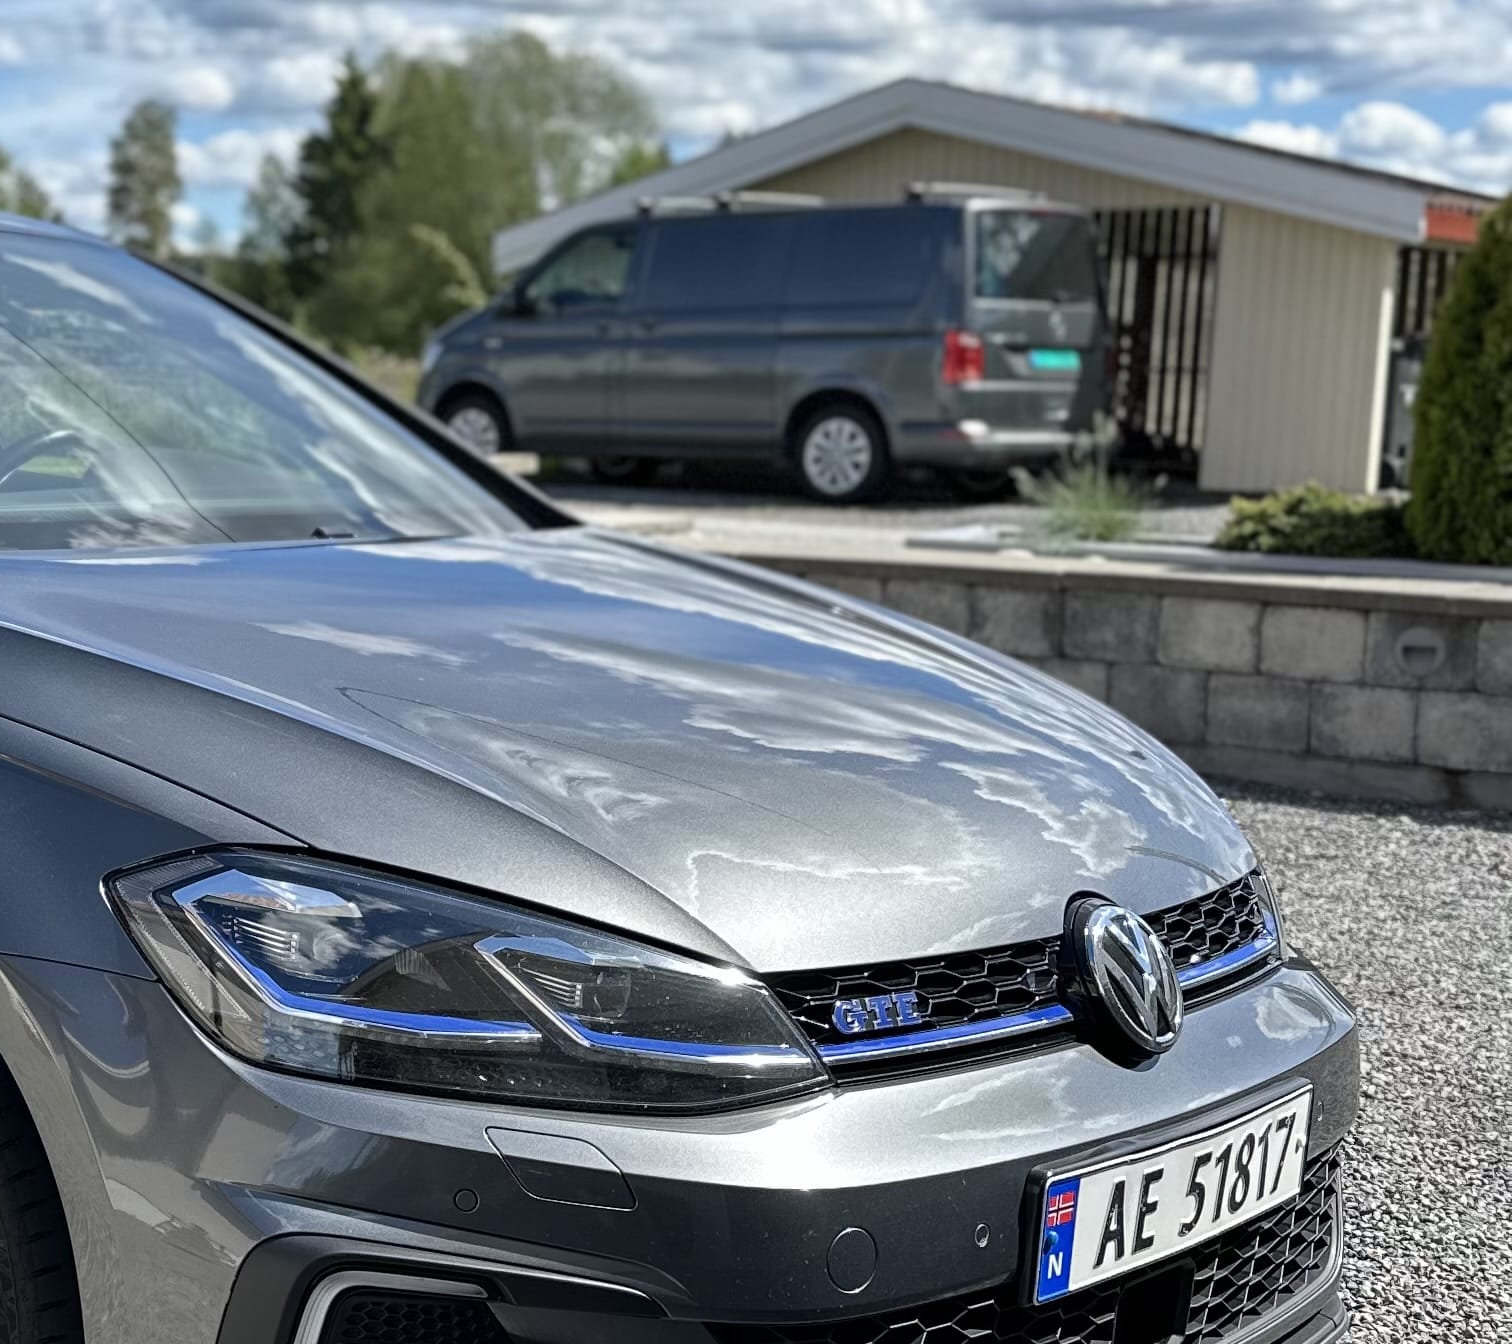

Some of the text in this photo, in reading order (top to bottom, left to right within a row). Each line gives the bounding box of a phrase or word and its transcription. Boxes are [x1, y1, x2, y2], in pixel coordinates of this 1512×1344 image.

[832, 991, 921, 1035] GTE
[1092, 1111, 1297, 1269] AE 51817
[1047, 1251, 1063, 1279] N
